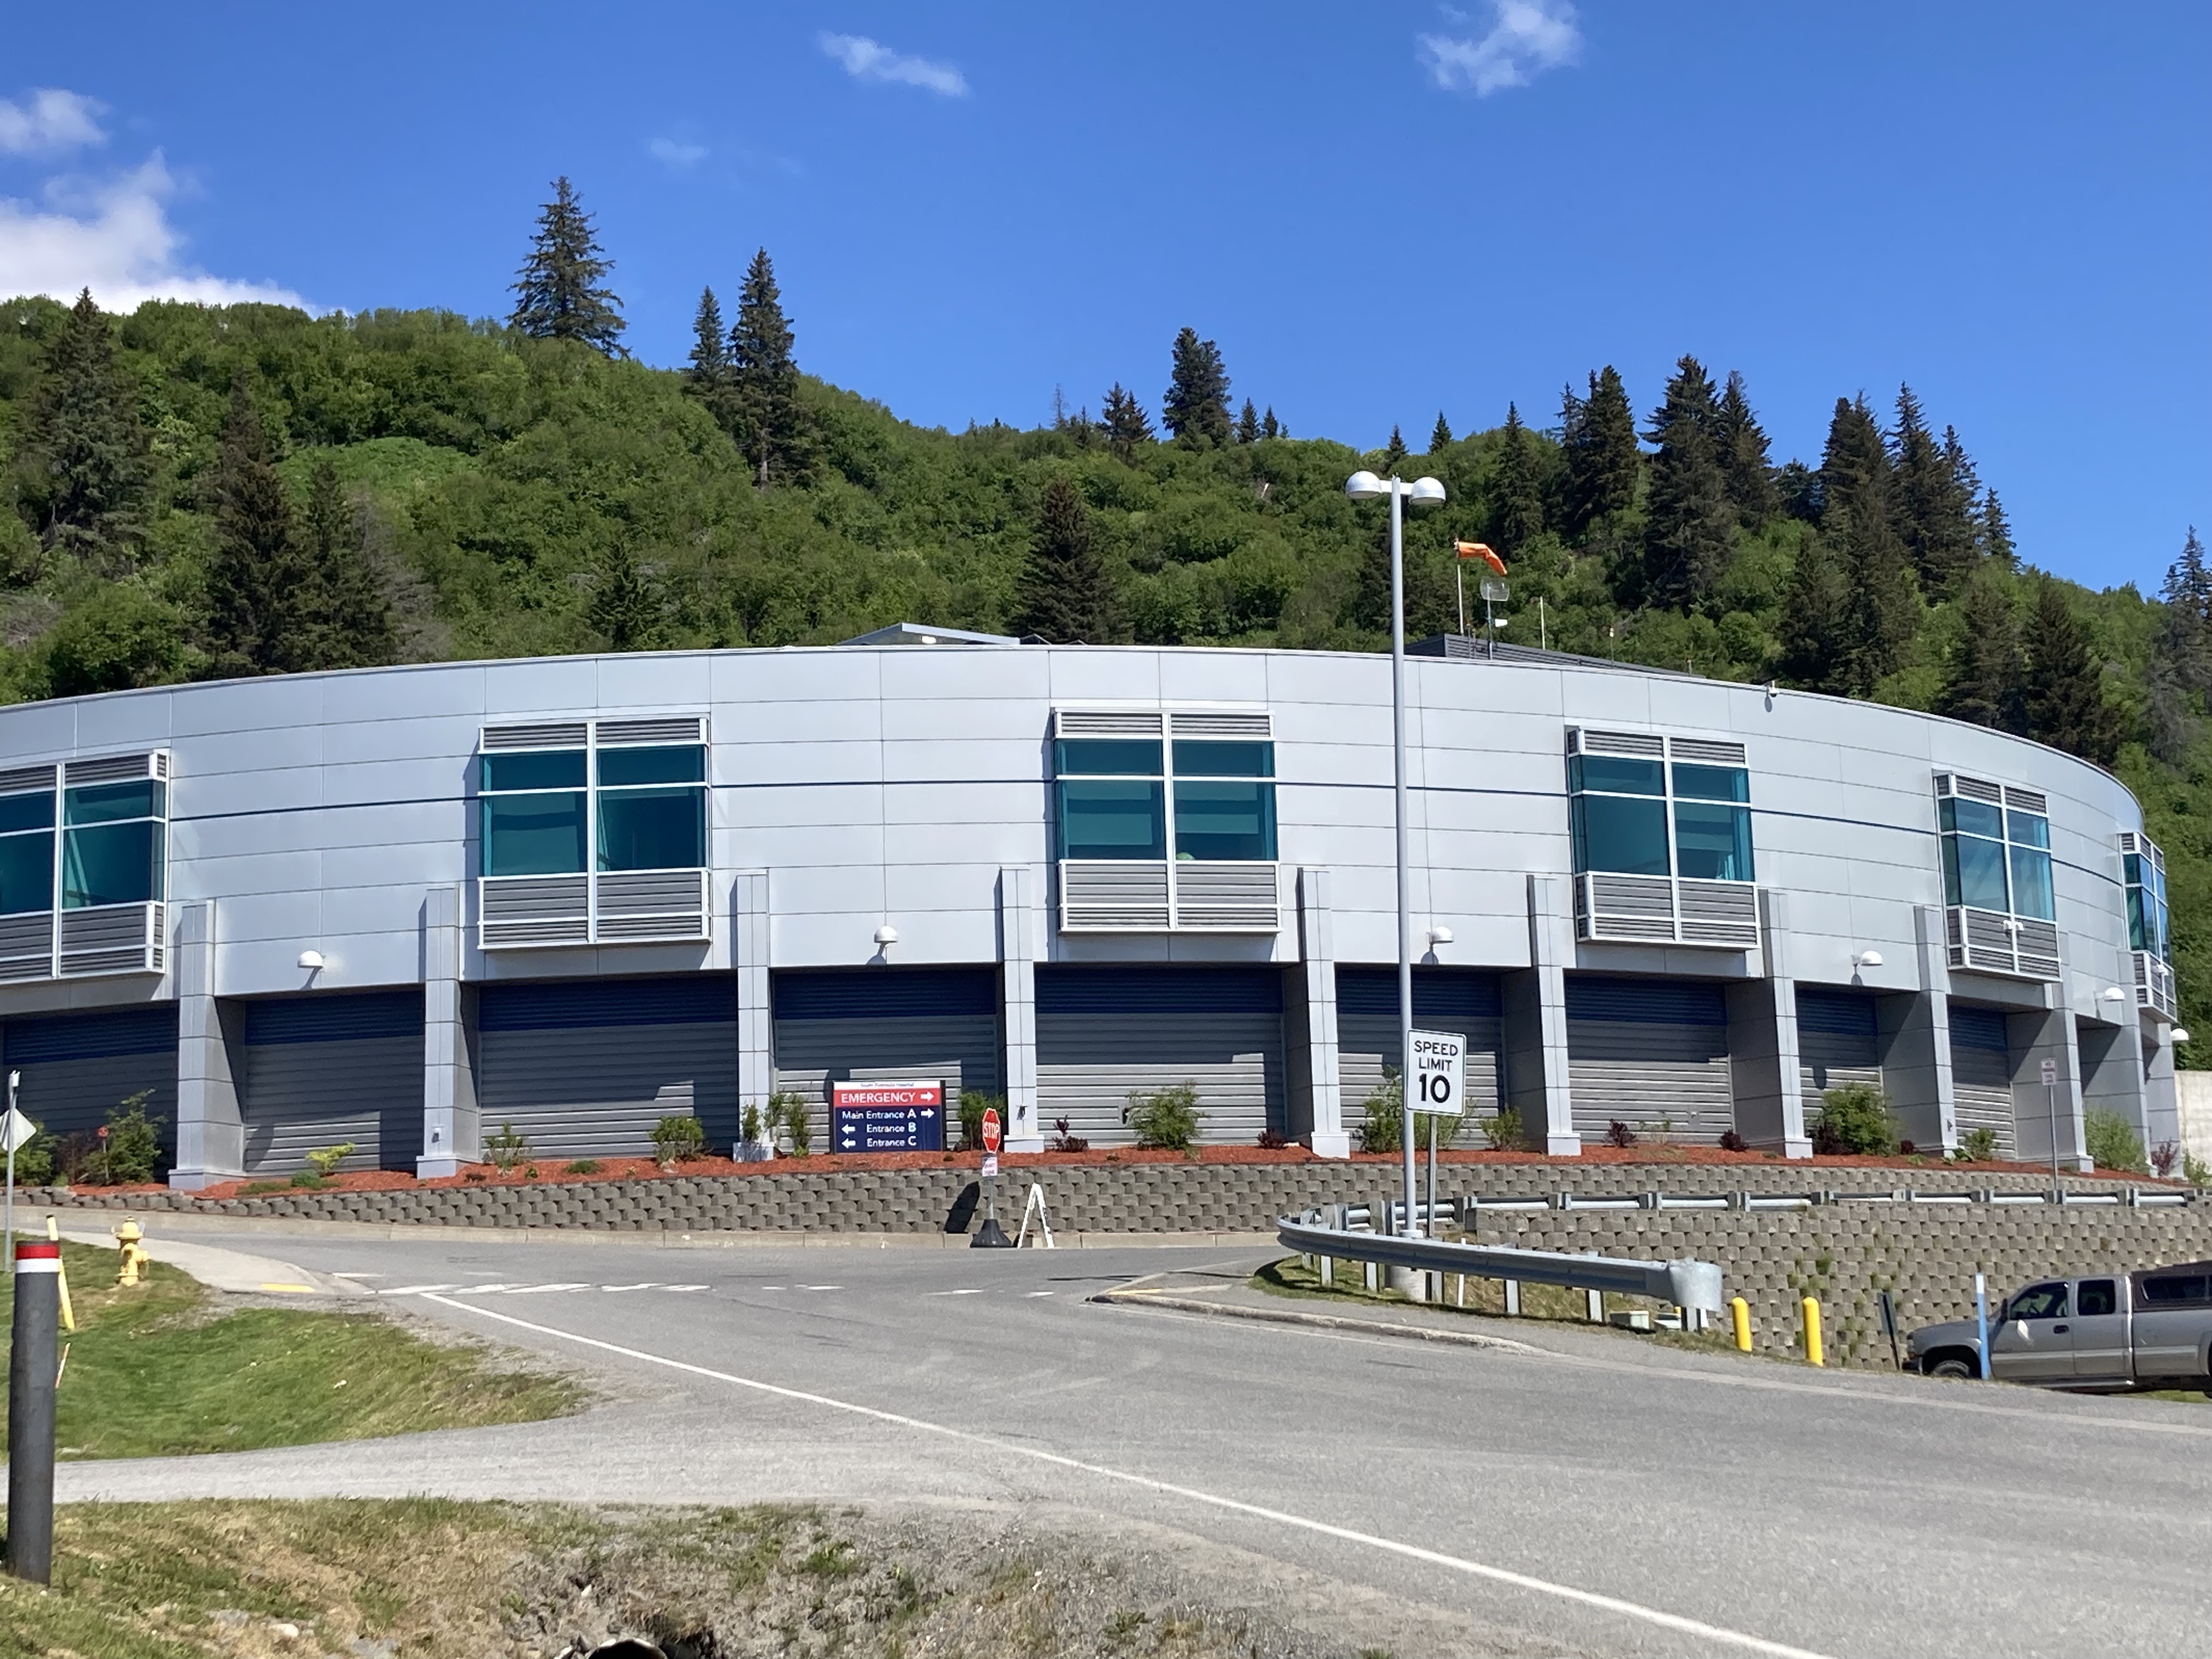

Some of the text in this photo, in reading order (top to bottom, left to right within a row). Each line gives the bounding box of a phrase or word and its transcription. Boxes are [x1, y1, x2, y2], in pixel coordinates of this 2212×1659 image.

[1414, 1040, 1458, 1056] SPEED
[1419, 1057, 1453, 1072] LIMIT
[1419, 1073, 1451, 1103] 10
[841, 1092, 916, 1103] EMERGENCY
[842, 1108, 917, 1119] Main Entrance A
[866, 1122, 916, 1133] Entrance B
[984, 1121, 999, 1139] STOP
[866, 1136, 917, 1147] Entrance C
